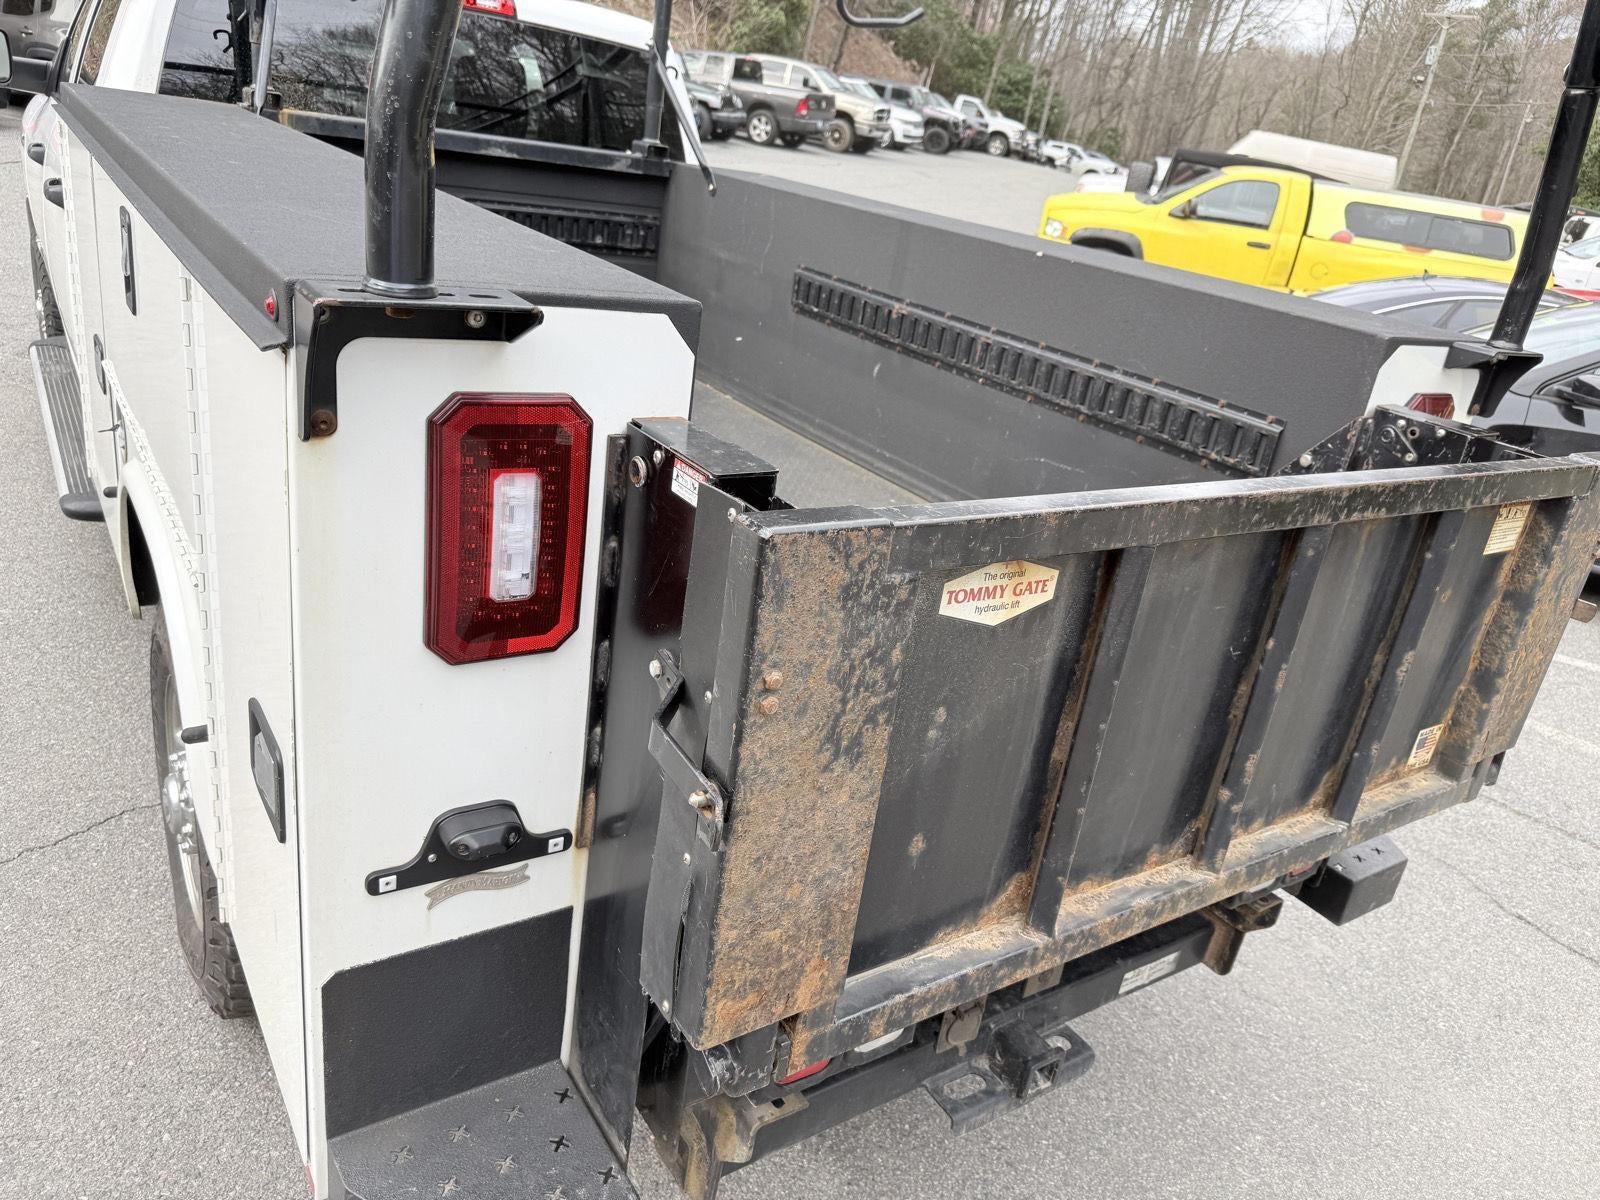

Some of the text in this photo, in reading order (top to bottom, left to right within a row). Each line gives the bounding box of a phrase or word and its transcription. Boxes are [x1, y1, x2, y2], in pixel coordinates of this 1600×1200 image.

[681, 464, 705, 482] DANGER
[984, 568, 1027, 582] The original
[946, 584, 1008, 605] TOMMY
[974, 599, 1021, 615] hydraulic lift
[1420, 727, 1436, 737] MADE
